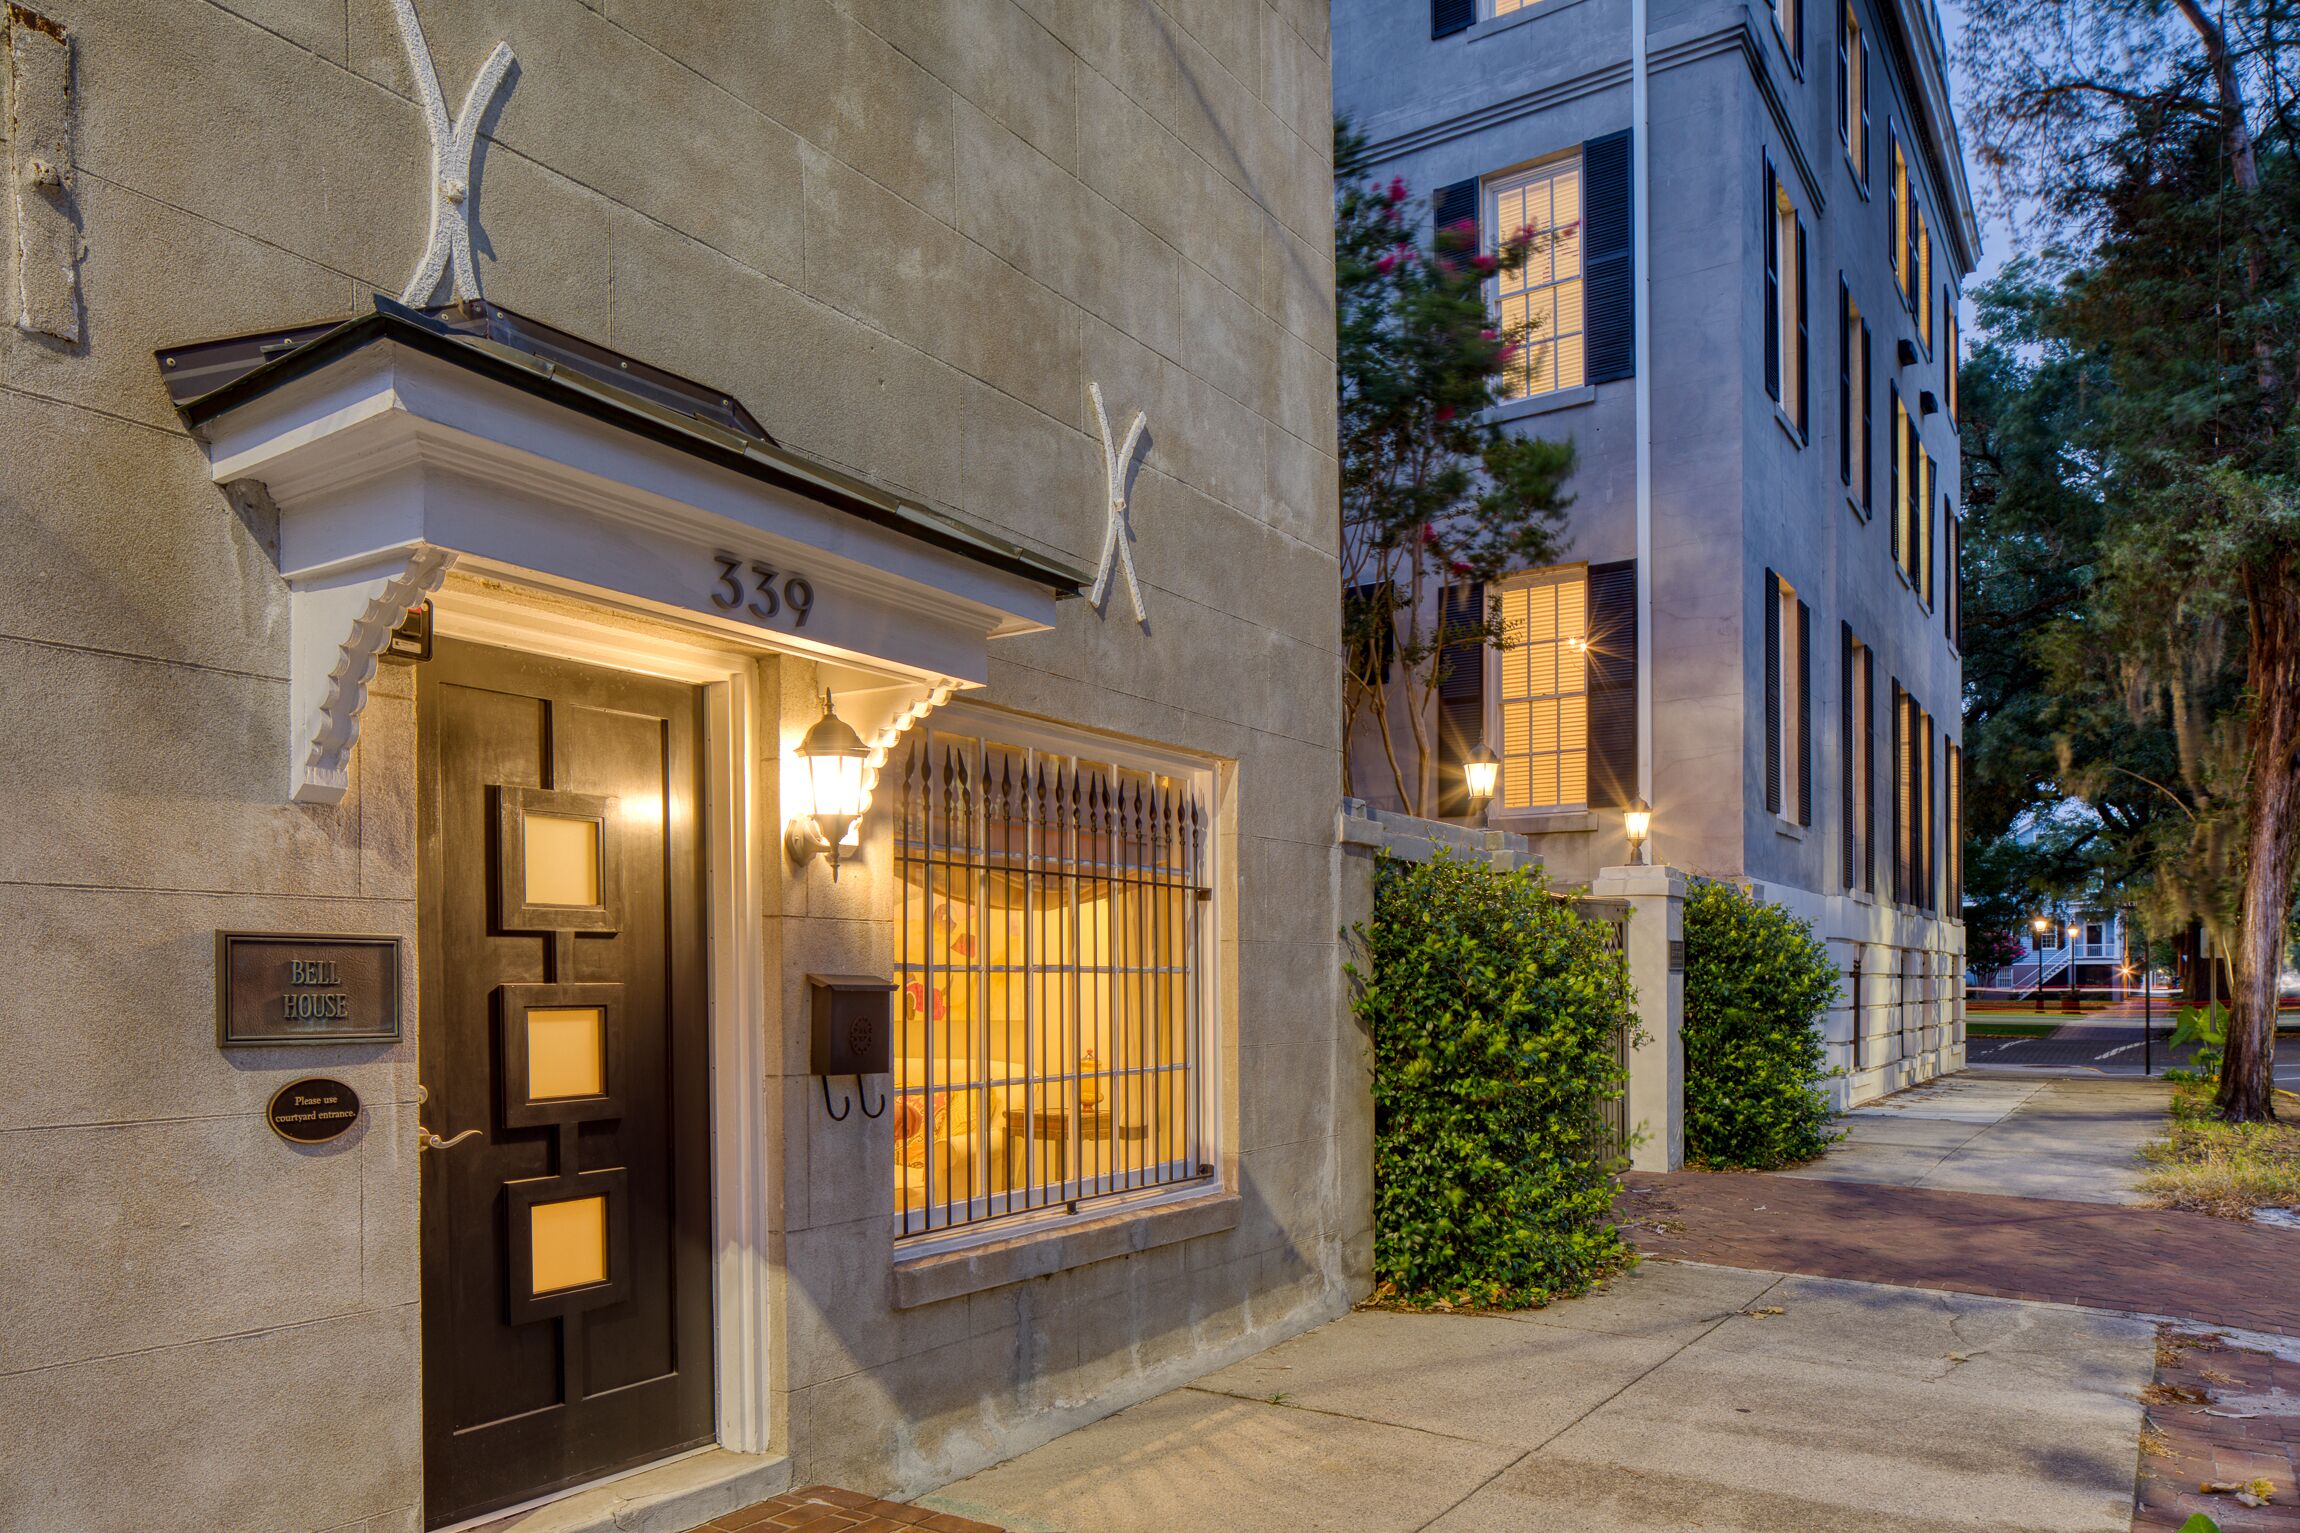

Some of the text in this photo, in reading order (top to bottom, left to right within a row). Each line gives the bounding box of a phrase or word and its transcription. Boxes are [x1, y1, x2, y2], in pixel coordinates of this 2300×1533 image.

[711, 555, 815, 627] 339
[290, 959, 341, 985] BELL
[283, 993, 348, 1018] HOUSE
[294, 1095, 338, 1106] Please use
[275, 1109, 356, 1123] courtyard entrance.
